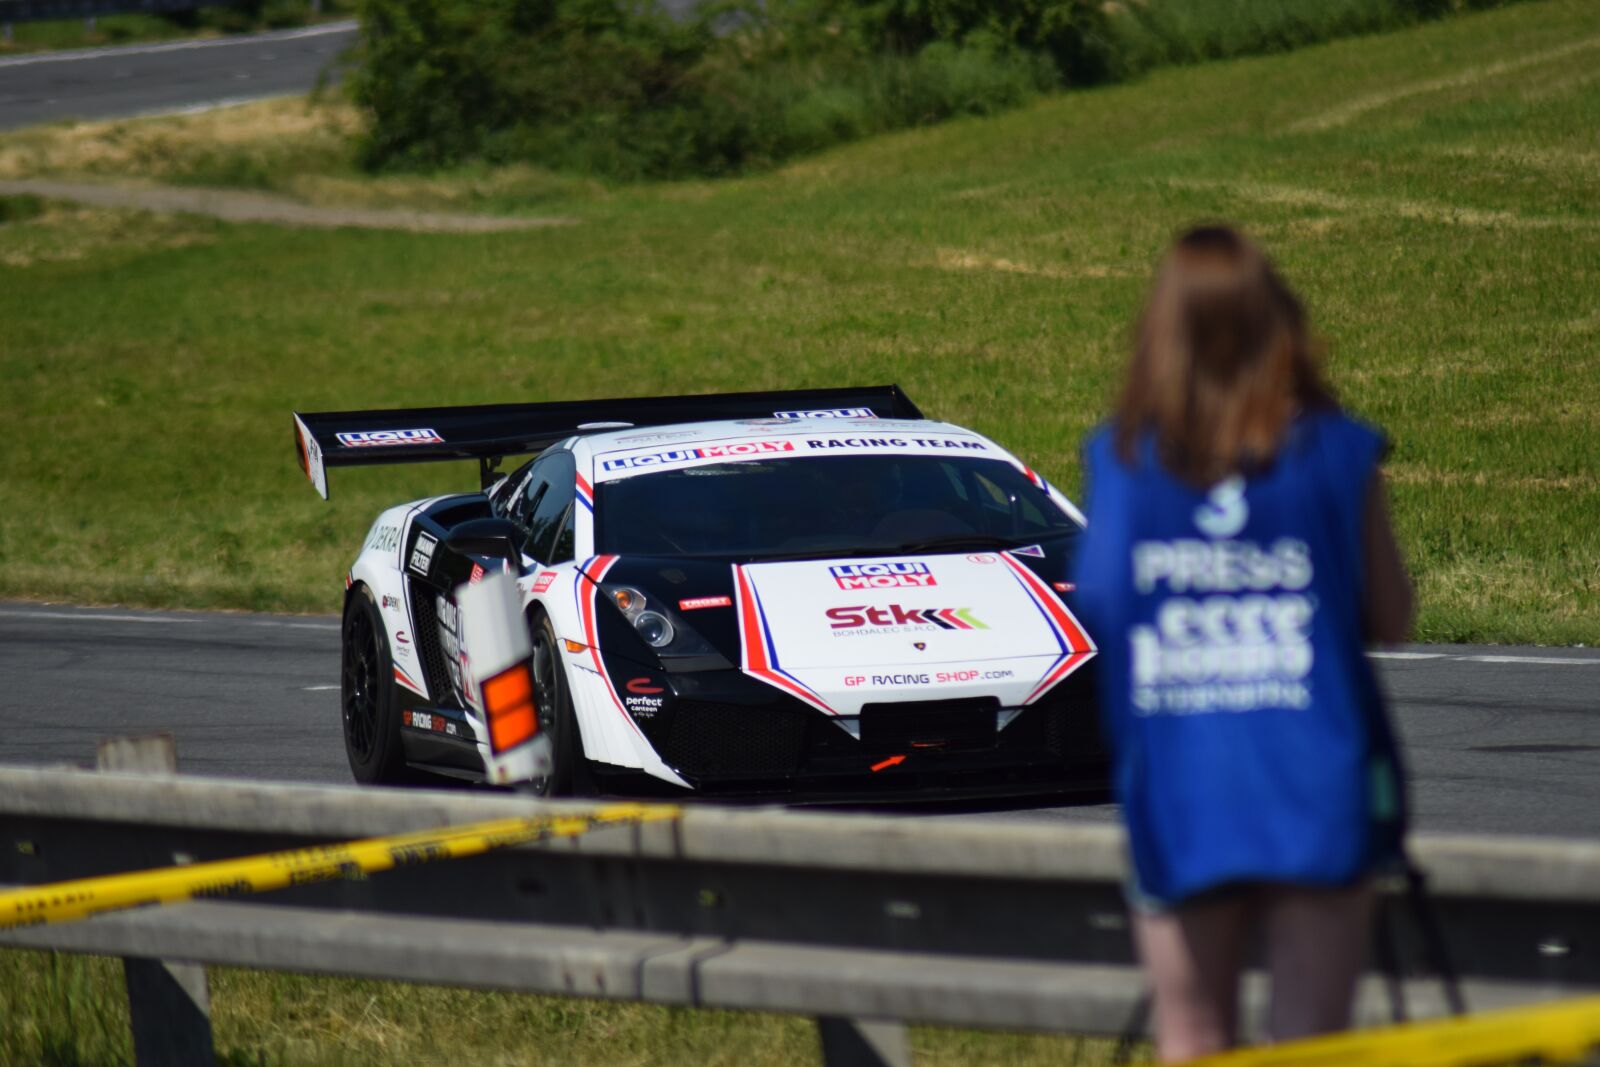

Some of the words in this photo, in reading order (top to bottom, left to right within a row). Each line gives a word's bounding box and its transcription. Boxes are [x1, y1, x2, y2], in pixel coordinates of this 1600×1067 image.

[343, 429, 432, 441] LIQUI
[608, 449, 698, 471] LIQUI
[702, 442, 788, 458] MOLY
[806, 438, 907, 449] RACING
[912, 438, 988, 450] TEAM
[410, 551, 431, 572] FILTER
[832, 562, 928, 577] LIQUI
[1133, 539, 1312, 593] PRESS
[840, 574, 931, 590] MOLY
[825, 604, 930, 629] Stk
[833, 626, 900, 637] BOHDALEC
[844, 675, 866, 687] GP
[872, 674, 930, 685] RACING
[626, 696, 662, 706] perfect
[412, 711, 432, 729] RACING
